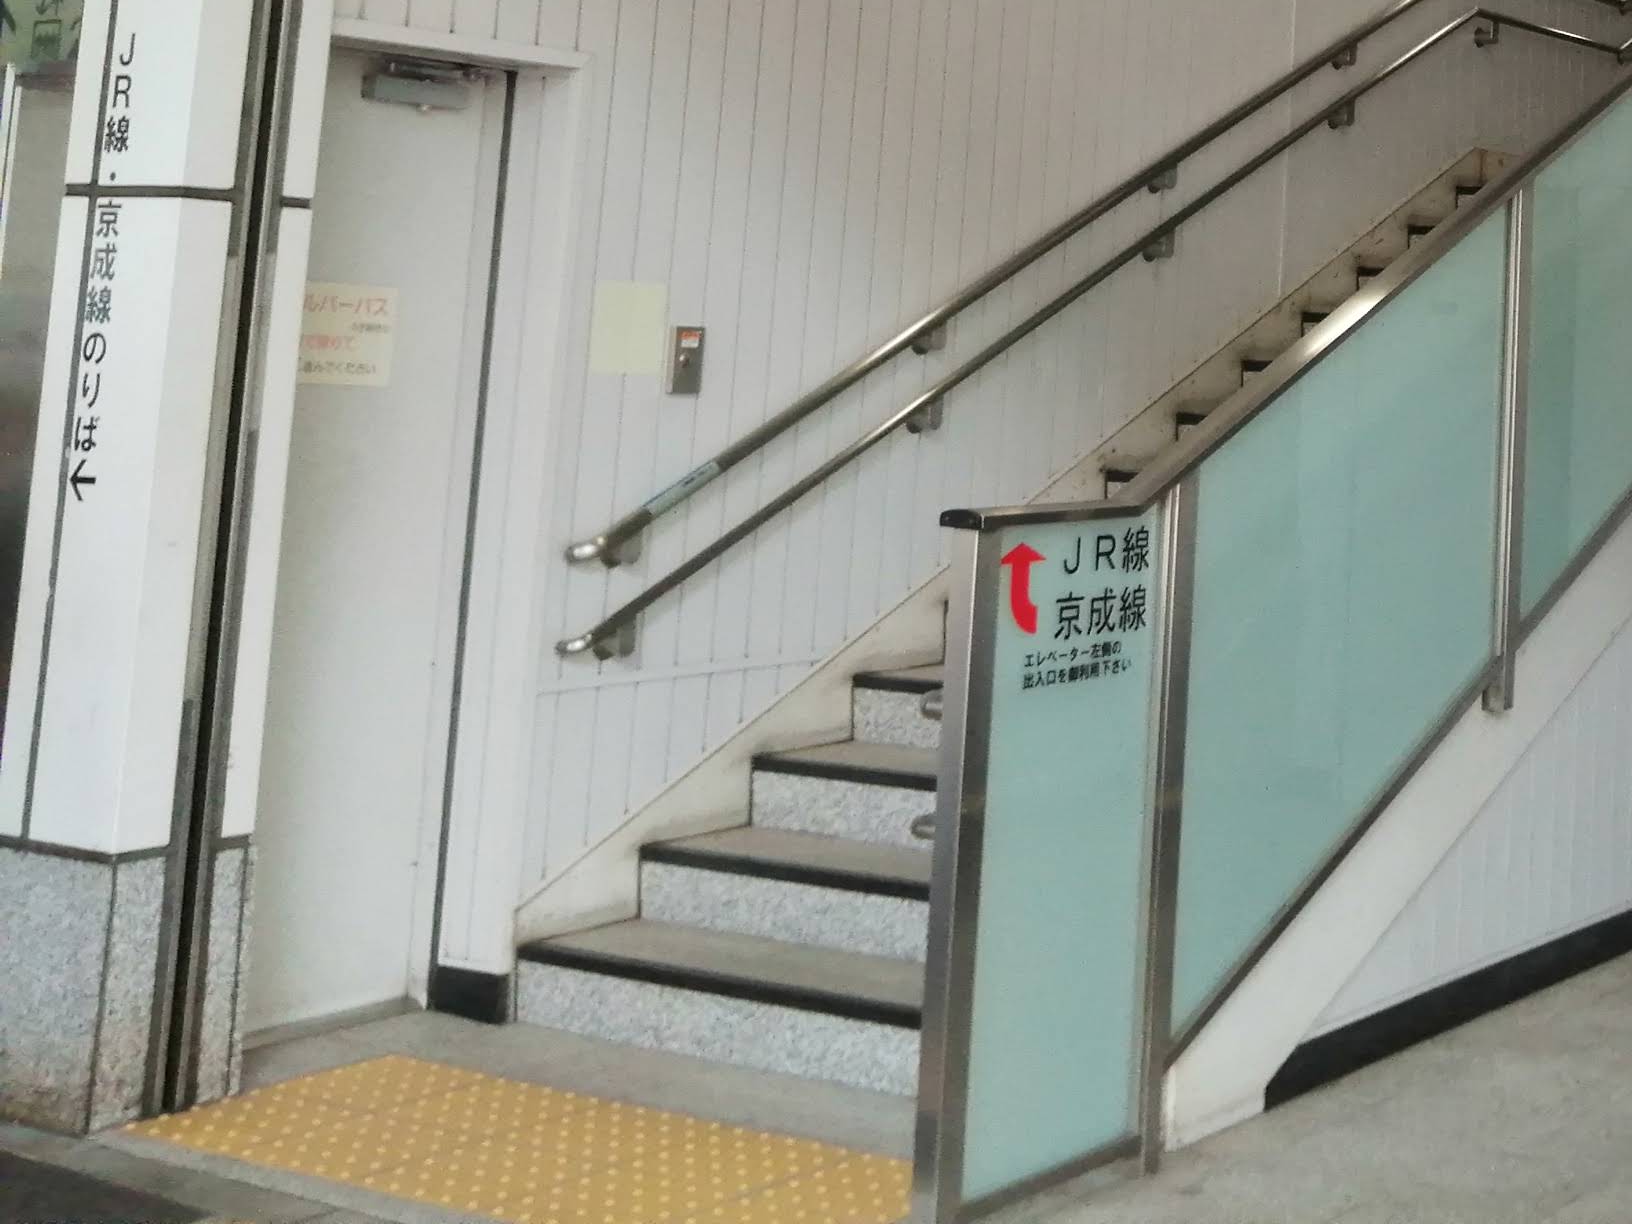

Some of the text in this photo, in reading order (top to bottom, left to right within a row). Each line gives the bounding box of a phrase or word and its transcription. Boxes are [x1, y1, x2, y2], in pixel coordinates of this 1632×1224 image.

[1063, 525, 1150, 575] JR線
[1054, 583, 1147, 640] 京成線
